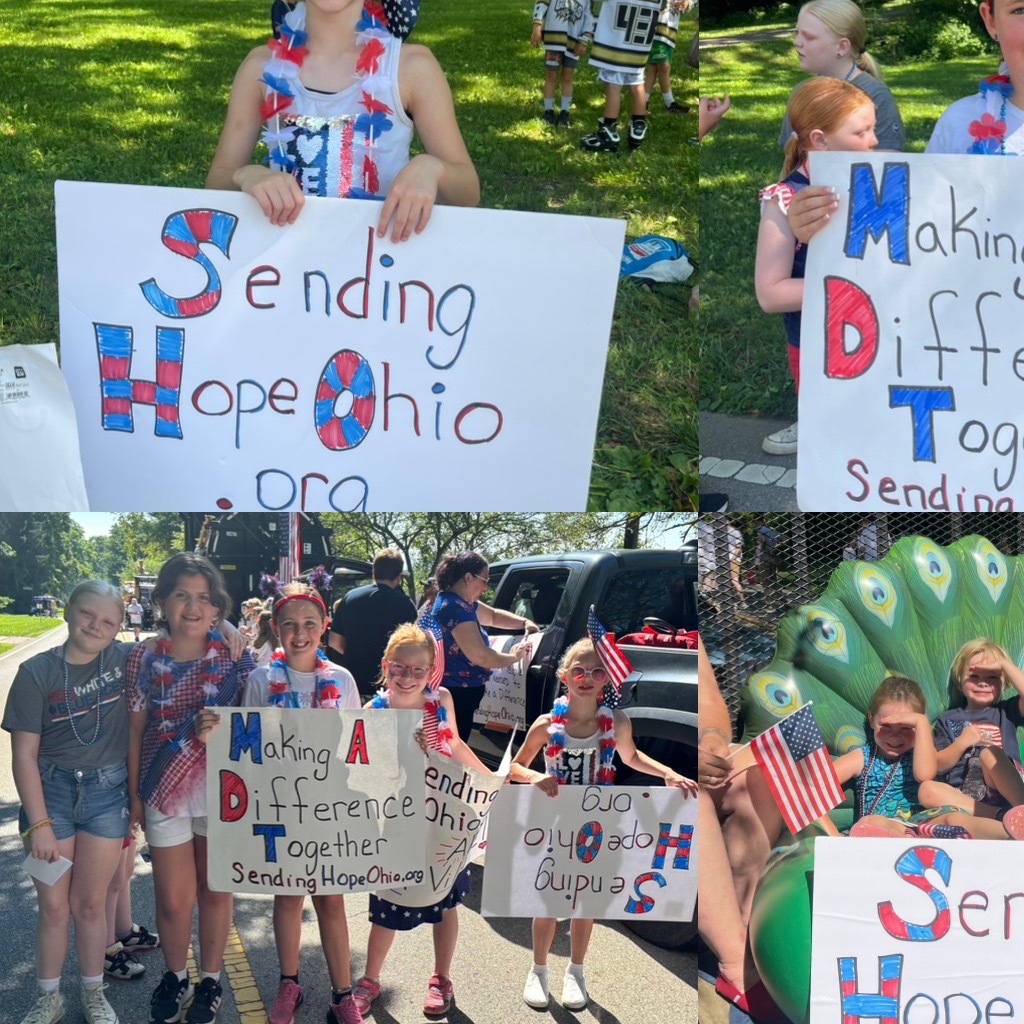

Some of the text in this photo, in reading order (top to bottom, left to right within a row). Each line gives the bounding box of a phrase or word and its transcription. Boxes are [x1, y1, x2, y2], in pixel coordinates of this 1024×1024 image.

[139, 208, 476, 370] Sending
[73, 671, 114, 697] WHITE
[229, 712, 370, 782] Making A
[219, 769, 416, 824] Difference
[425, 766, 499, 817] ending
[252, 824, 389, 876] Together
[231, 862, 424, 895] SendingHopeOhio.org
[534, 857, 668, 915] Sending
